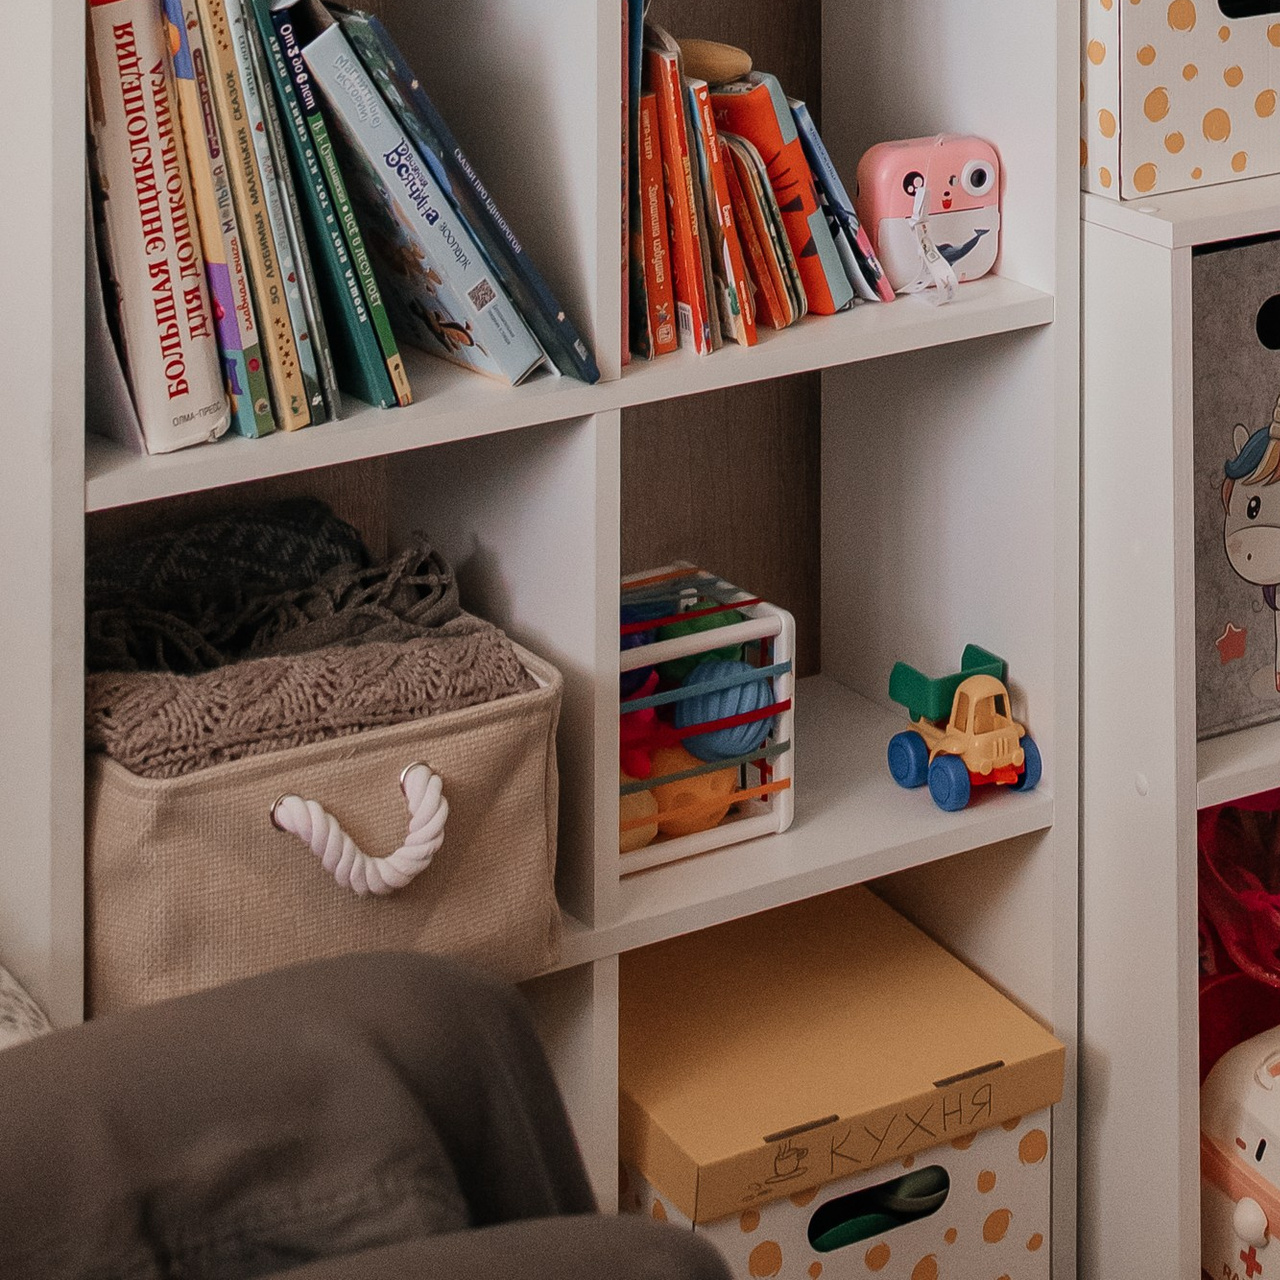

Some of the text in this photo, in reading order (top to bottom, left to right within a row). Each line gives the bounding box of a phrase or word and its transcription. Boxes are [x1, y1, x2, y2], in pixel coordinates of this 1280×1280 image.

[269, 36, 287, 77] ПРУДУ
[280, 23, 297, 46] От
[292, 58, 303, 73] до
[301, 84, 316, 110] лет
[290, 101, 306, 142] СИДИТ
[226, 72, 280, 305] 50 ЛЮБИМЫХ МАЛЕНЬКИХ СКАЗОК
[305, 149, 317, 174] КТО
[113, 21, 190, 400] БОЛЬШАЯ ЭНЦИКЛОПЕДИЯ
[150, 58, 211, 341] ДЛЯ ДОШКОЛЬНИКА
[326, 214, 334, 224] И
[383, 137, 472, 271] Всячина зоопарк
[454, 148, 523, 254] СКАЗКИ ПРО ЕДИНОРОГОВ
[648, 183, 661, 237] Заюшкина
[331, 230, 348, 263] ЕНОТ
[355, 247, 371, 277] ЛЕСУ
[652, 238, 665, 284] избушка
[230, 236, 254, 331] главная книга
[345, 268, 366, 323] КРОШКА
[172, 401, 222, 427] ОЛМА-ПРЕСС
[830, 1083, 992, 1175] КУХНЯ
